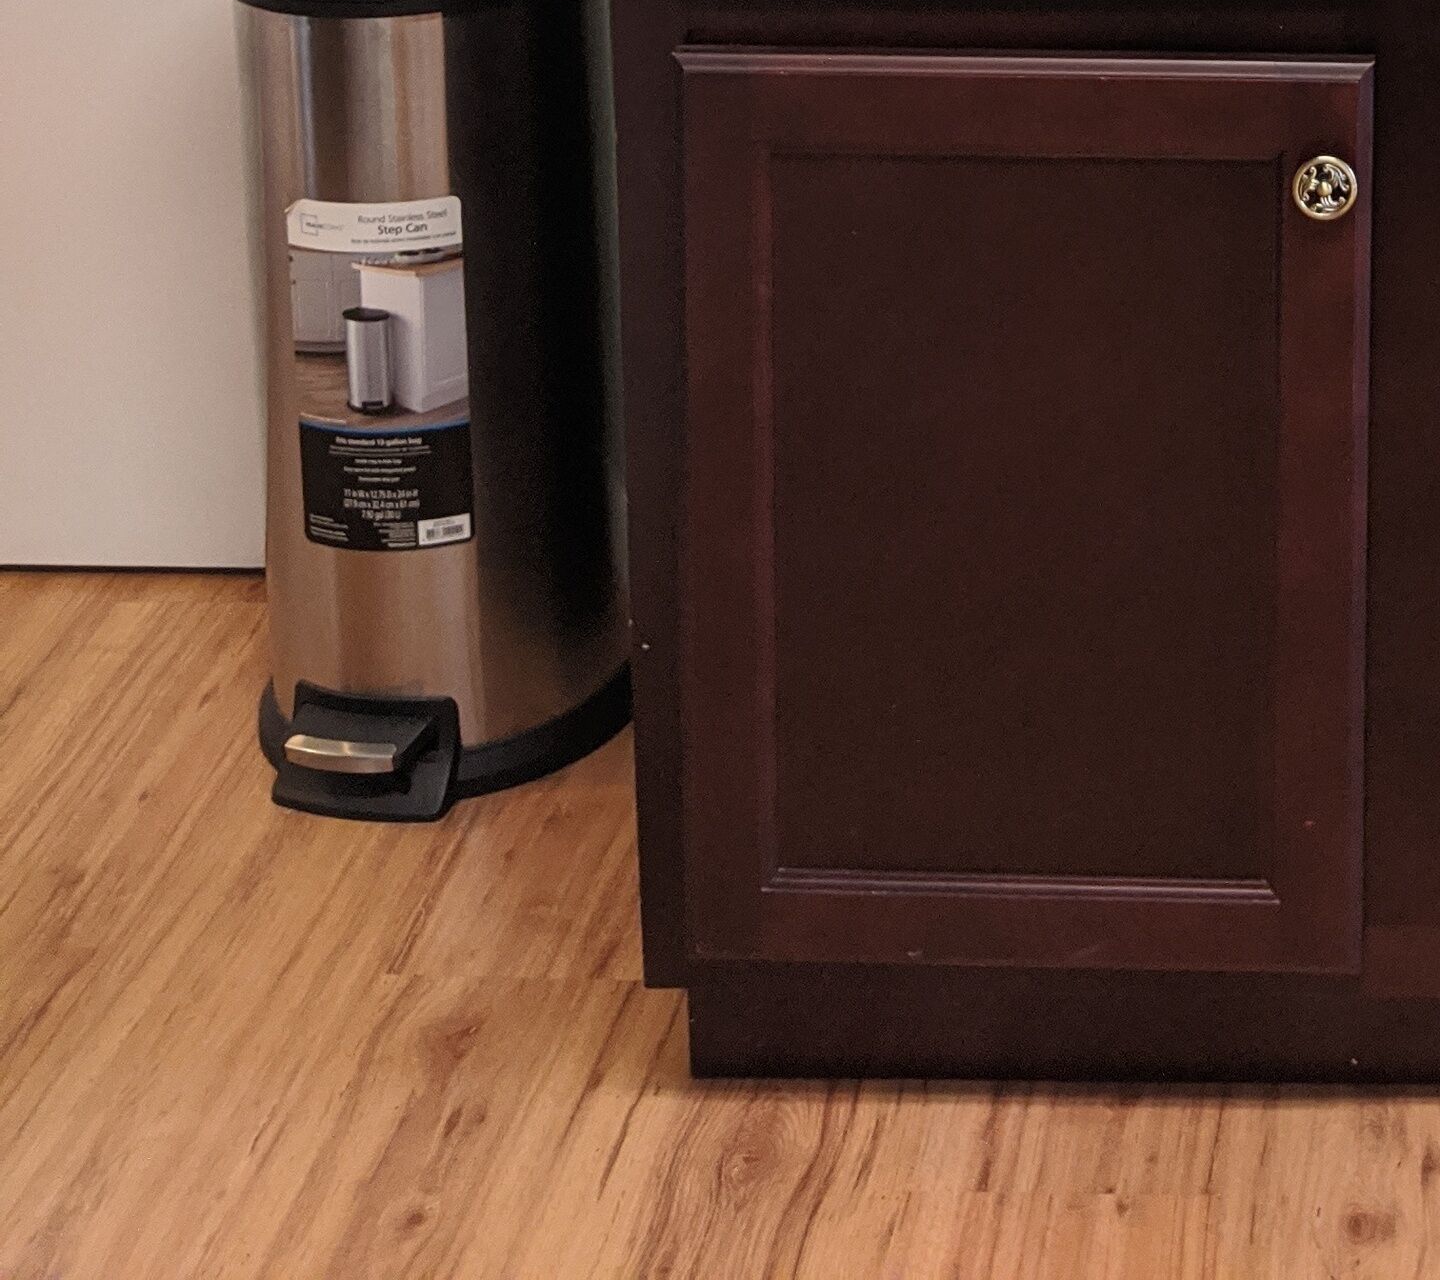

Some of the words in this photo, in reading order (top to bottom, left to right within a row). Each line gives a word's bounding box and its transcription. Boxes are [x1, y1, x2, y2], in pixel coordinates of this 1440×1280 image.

[357, 215, 386, 224] Round
[388, 212, 425, 223] Stainless
[426, 208, 448, 220] Steel
[377, 225, 403, 237] Step
[405, 222, 428, 233] Can
